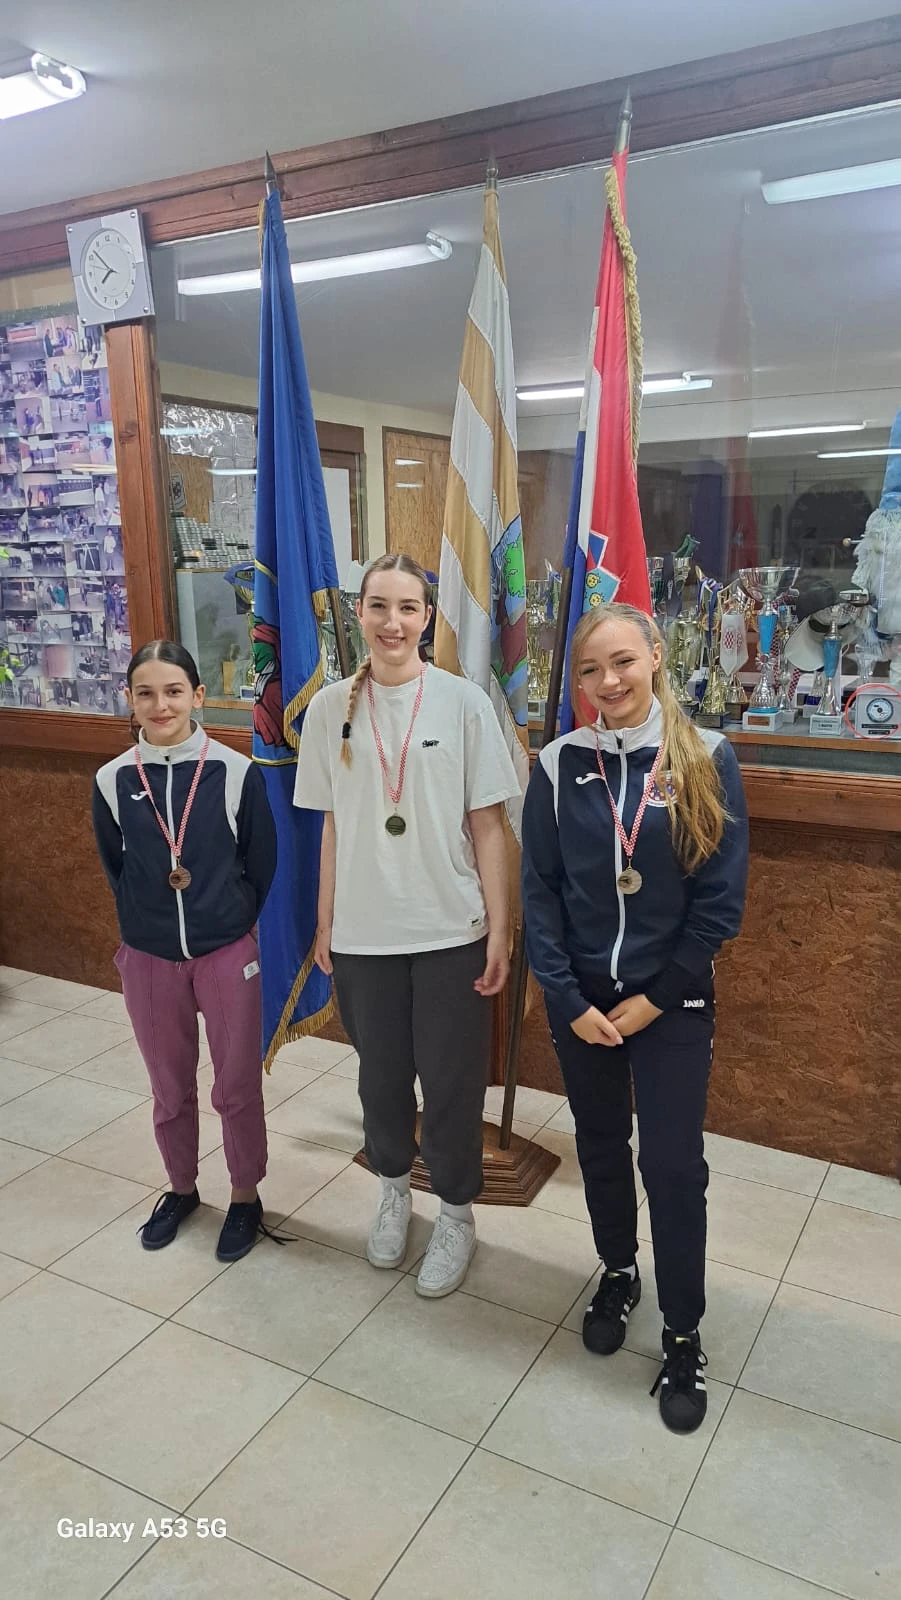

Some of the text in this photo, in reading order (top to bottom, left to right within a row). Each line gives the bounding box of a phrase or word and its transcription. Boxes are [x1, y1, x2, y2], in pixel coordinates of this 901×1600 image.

[104, 234, 110, 242] 12
[125, 291, 129, 299] 5
[103, 296, 107, 304] 7
[683, 999, 705, 1008] JAKO
